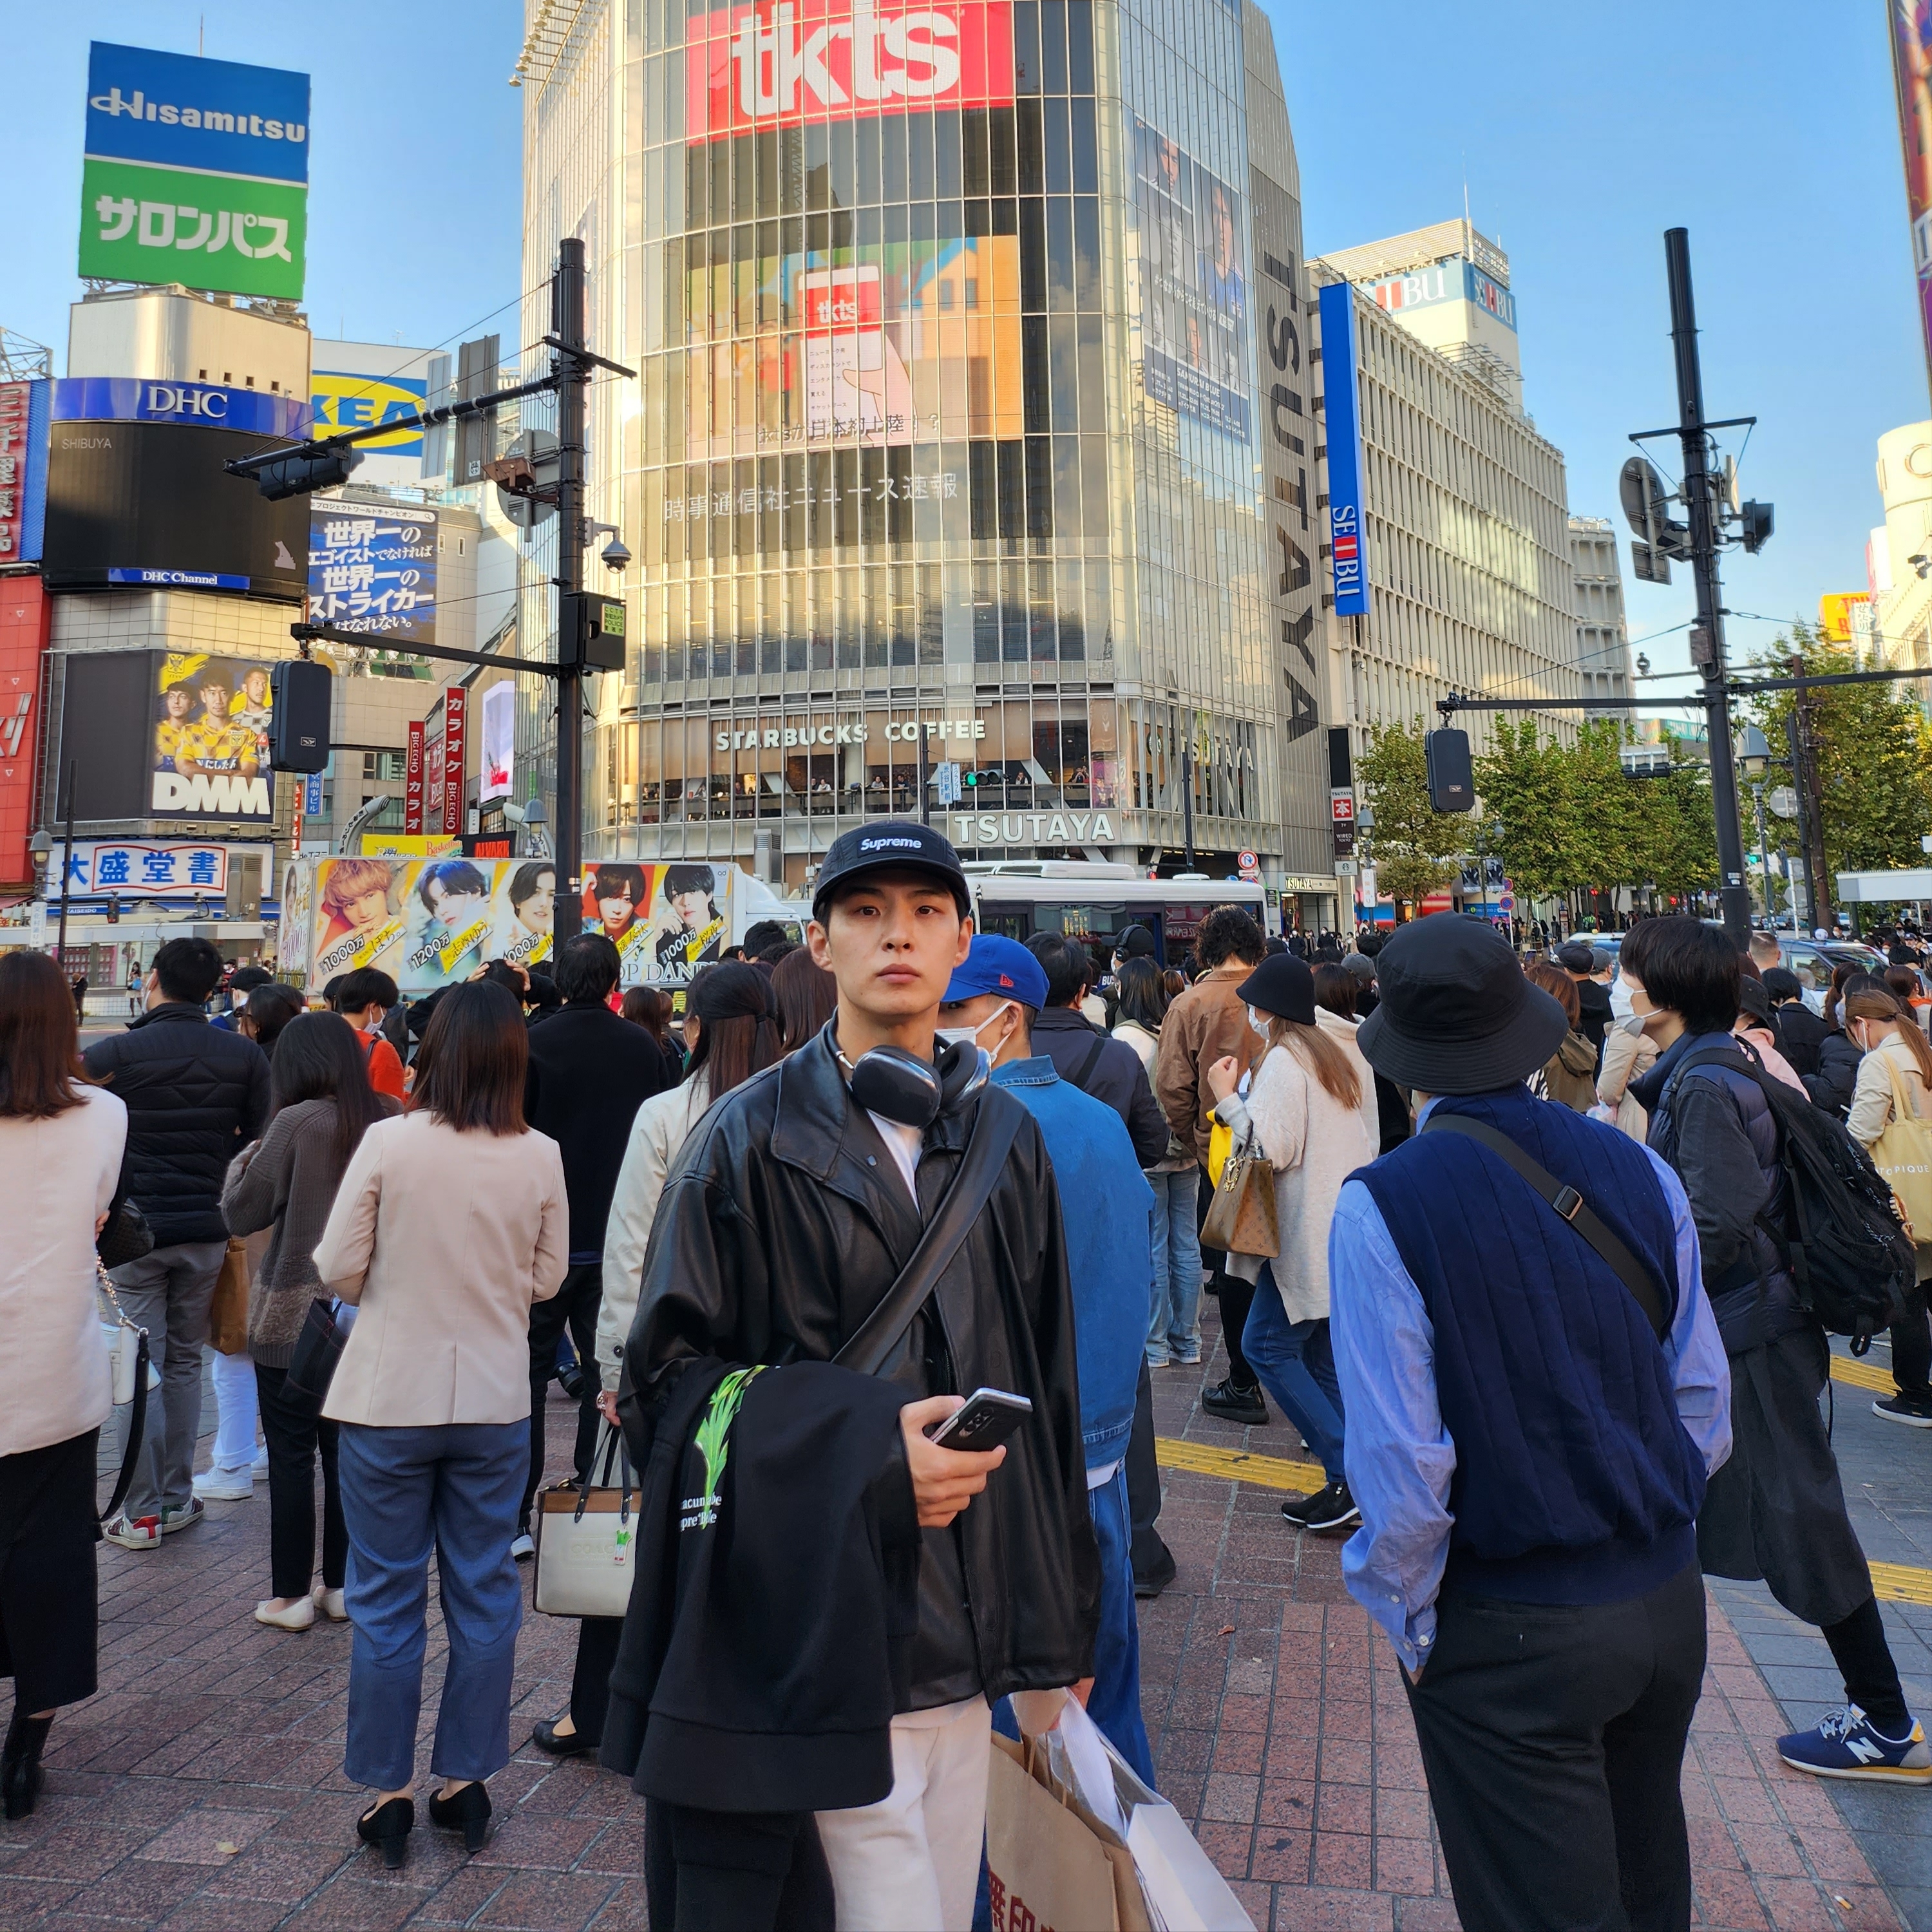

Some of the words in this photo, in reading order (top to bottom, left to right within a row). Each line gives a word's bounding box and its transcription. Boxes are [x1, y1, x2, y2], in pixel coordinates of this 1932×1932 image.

[732, 0, 959, 117] tkts
[90, 88, 305, 142] Hisamitsu
[96, 195, 292, 263] サロンパス
[1362, 269, 1447, 313] IBU
[817, 299, 859, 323] tkts
[148, 386, 227, 418] DHC
[1205, 382, 1221, 398] BLUE
[312, 393, 421, 428] KEA
[62, 439, 112, 449] SHIBUYA
[664, 473, 958, 522] 時事通信社ニュース速報
[1264, 250, 1318, 742] TSUTAYA
[324, 520, 421, 548] 世界一の
[308, 545, 433, 566] エゴイストでなければ
[1332, 505, 1361, 598] SEIBU
[143, 571, 170, 582] DHC
[171, 572, 218, 585] Channel
[323, 564, 420, 593] 世界一の
[310, 587, 434, 620] ストライカー
[605, 606, 623, 614] CCTV
[605, 618, 623, 627] POLICE
[411, 732, 420, 747] BIG
[446, 697, 463, 773] カラオケ
[715, 722, 869, 752] STARBUCKS
[884, 719, 986, 742] COFFEE
[410, 748, 419, 773] ECHO
[153, 772, 270, 815] DMM
[407, 781, 421, 830] カラオ
[447, 782, 457, 801] BIG
[446, 801, 457, 830] ECHO
[1336, 800, 1350, 817] 本
[954, 813, 1115, 843] TSUTAYA
[860, 838, 922, 851] Supreme
[59, 849, 219, 887] 大盛堂書
[1285, 877, 1313, 890] TSUTAYA
[324, 933, 365, 972] 1000万
[412, 931, 450, 969] 1200万
[504, 933, 540, 963] 000万
[663, 927, 697, 961] 1000万
[647, 961, 719, 982] DAND
[987, 1861, 1056, 1932] 無印
